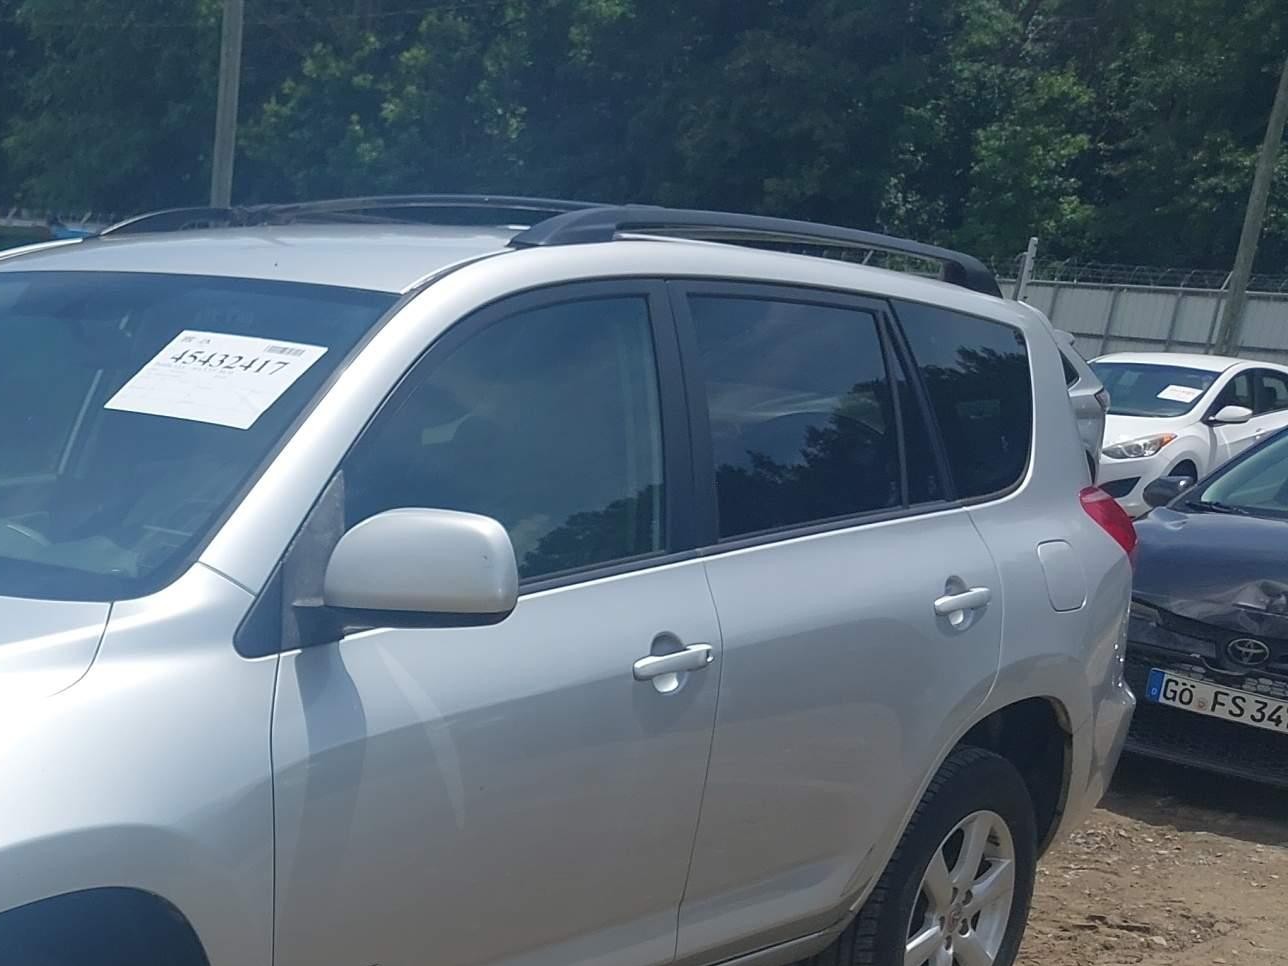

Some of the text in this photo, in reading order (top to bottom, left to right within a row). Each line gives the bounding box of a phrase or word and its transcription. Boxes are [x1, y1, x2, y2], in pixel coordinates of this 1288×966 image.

[169, 348, 291, 376] 45432417
[1162, 678, 1288, 729] GÖ FS 34
